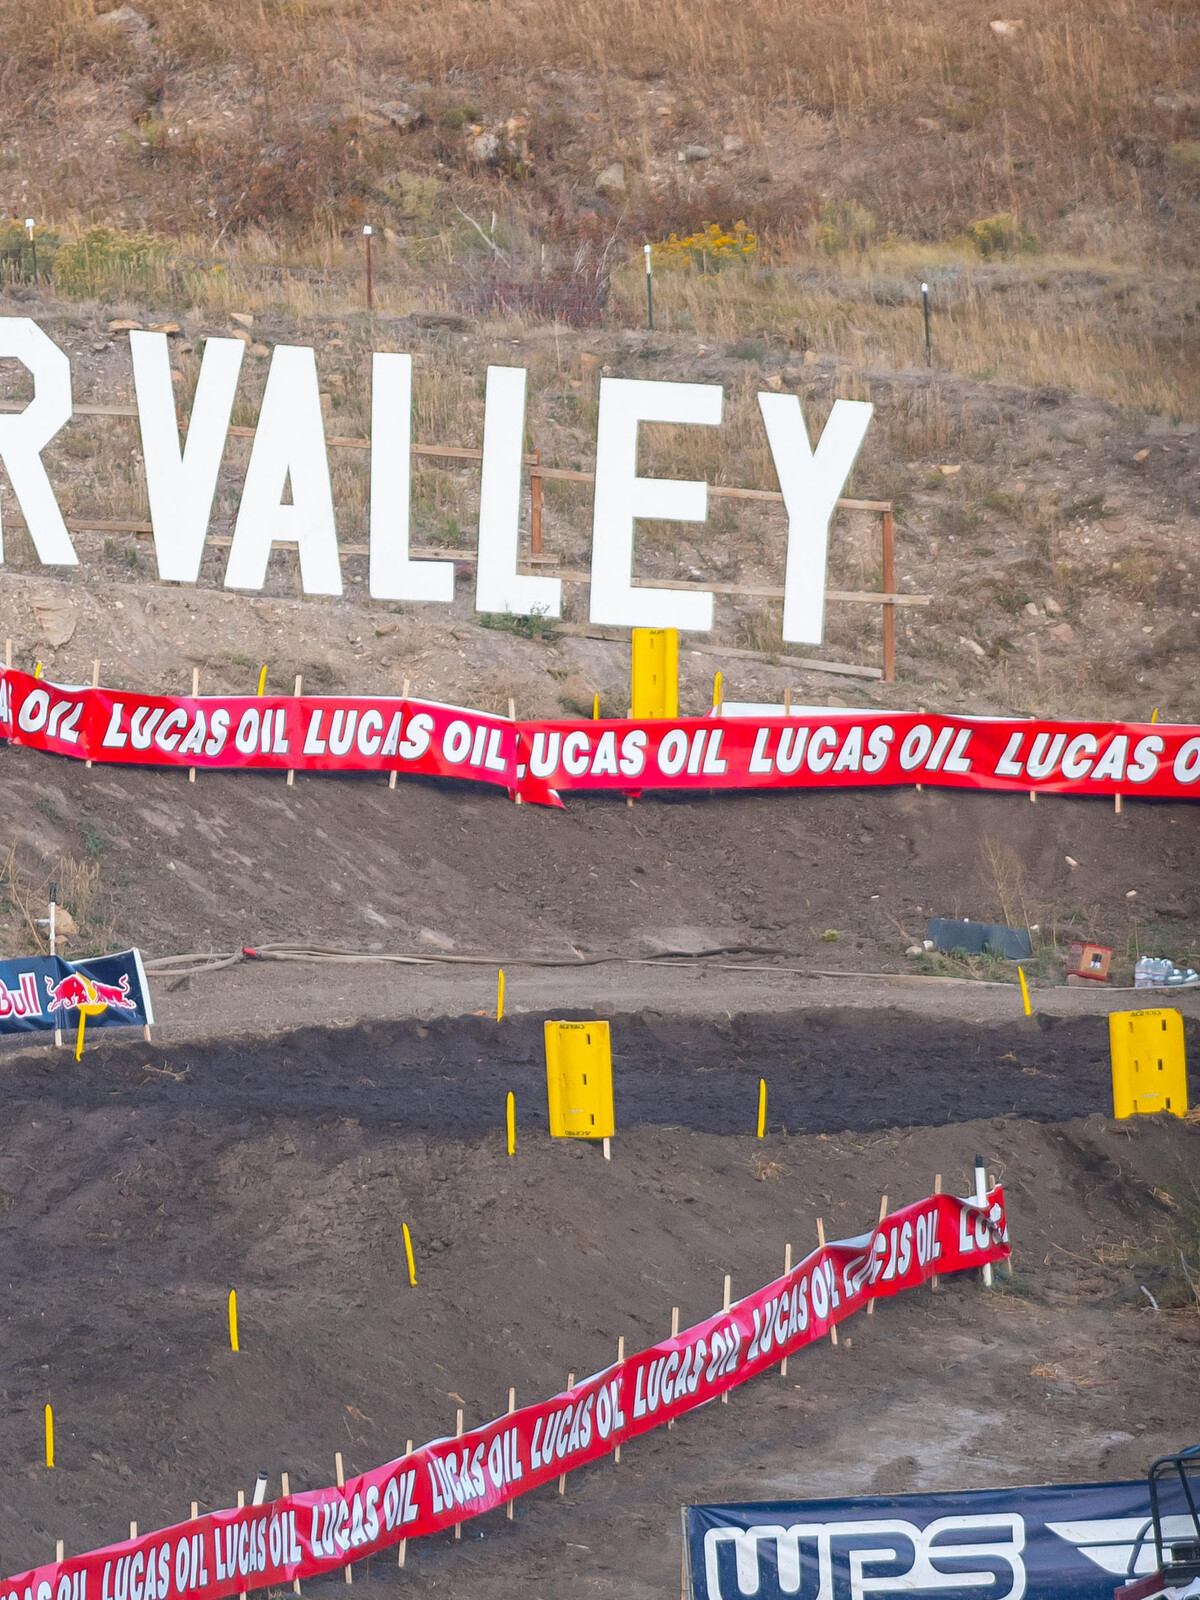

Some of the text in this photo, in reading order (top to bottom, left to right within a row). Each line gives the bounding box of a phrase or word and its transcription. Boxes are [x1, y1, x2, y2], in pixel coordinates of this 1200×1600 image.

[130, 328, 874, 645] VALLEY
[18, 688, 84, 744] OIL
[102, 702, 231, 757] LUCAS
[235, 707, 290, 755] OIL
[302, 707, 435, 760] LUCAS
[441, 718, 507, 772] OIL
[657, 728, 729, 776] OIL
[749, 724, 895, 774] LUCAS
[899, 723, 974, 773] OIL
[994, 731, 1165, 783] LUCAS
[102, 1542, 171, 1600] LUCAS
[175, 1533, 208, 1594] OIL
[214, 1515, 267, 1582] LUCAS
[269, 1510, 302, 1568] OIL
[310, 1485, 380, 1558] LUCAS
[383, 1469, 419, 1532] OIL
[427, 1442, 486, 1514] LUCAS
[488, 1426, 523, 1489] OIL
[531, 1390, 595, 1470] LUCAS
[633, 1338, 707, 1419] LUCAS
[706, 1322, 741, 1383] OIL
[747, 1275, 809, 1361] LUCAS
[916, 1208, 941, 1266] OIL
[704, 1512, 1026, 1600] WPS
